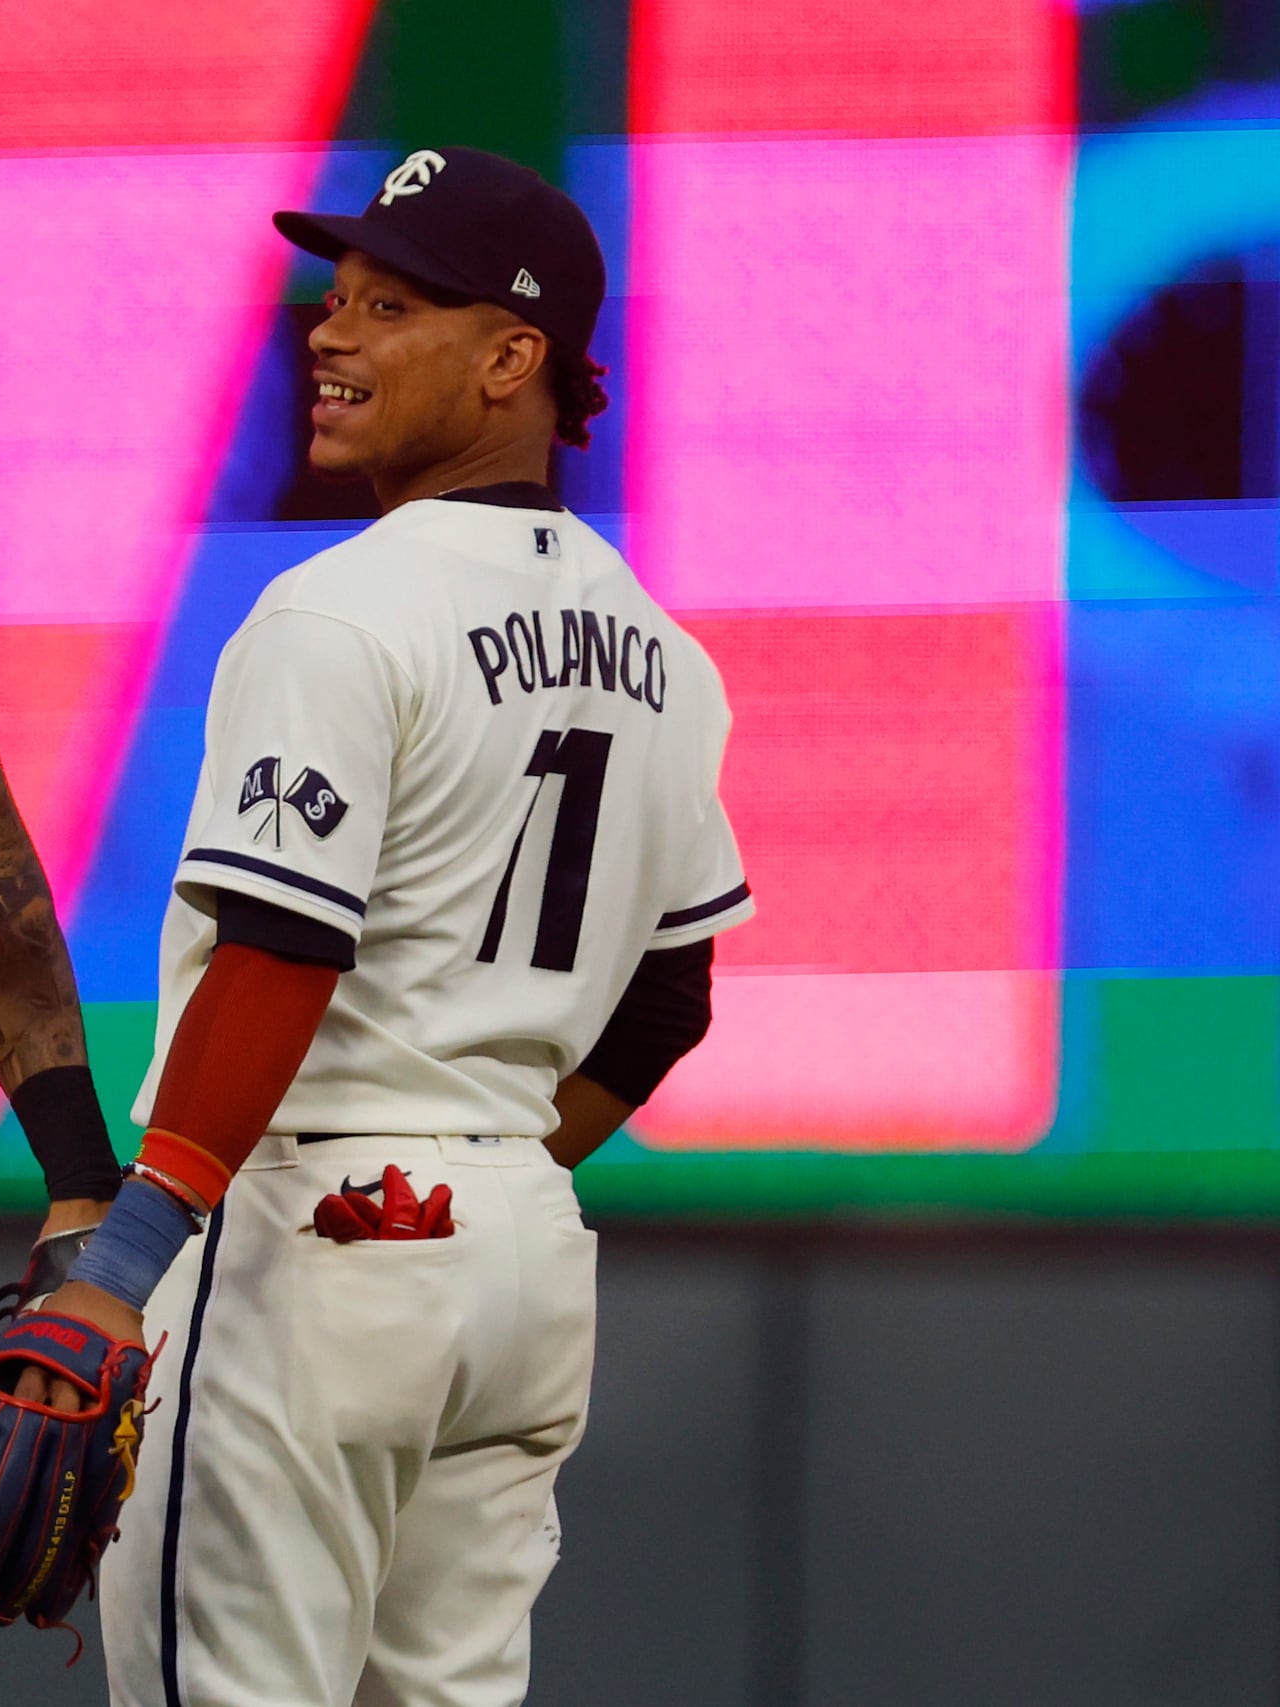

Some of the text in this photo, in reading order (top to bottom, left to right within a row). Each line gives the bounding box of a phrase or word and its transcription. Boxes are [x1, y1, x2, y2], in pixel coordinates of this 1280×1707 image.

[467, 608, 667, 714] POLANCO
[242, 767, 265, 805] M
[475, 727, 615, 973] 11
